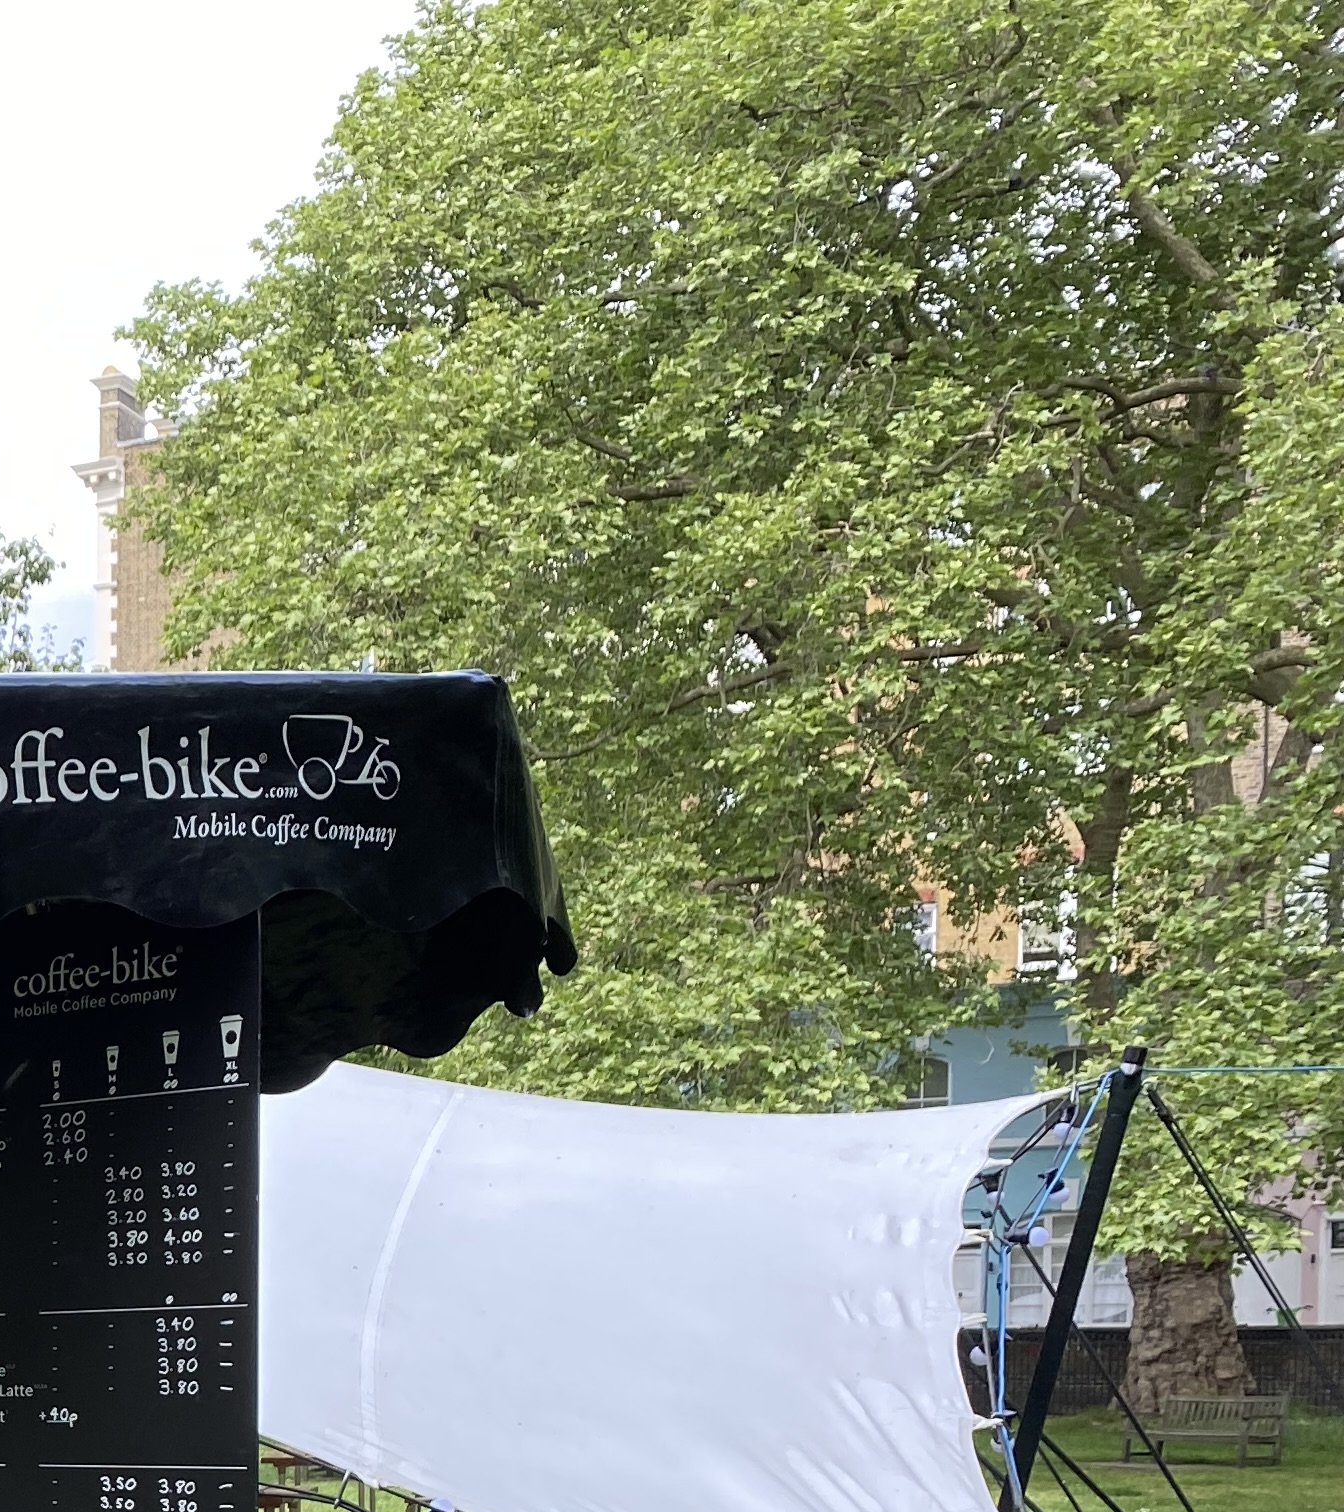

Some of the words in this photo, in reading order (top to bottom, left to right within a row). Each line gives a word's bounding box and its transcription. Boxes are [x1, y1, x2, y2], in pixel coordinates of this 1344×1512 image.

[172, 812, 246, 839] Mobile
[251, 814, 310, 846] Coffee
[314, 816, 397, 851] Company
[14, 941, 178, 997] coffee-bike
[14, 1001, 58, 1018] Mobile
[62, 995, 106, 1012] Coffee
[111, 988, 177, 1005] Company
[168, 1067, 174, 1077] L
[226, 1061, 238, 1071] XL
[42, 1110, 86, 1129] 2.00
[43, 1129, 85, 1145] 2.60
[43, 1147, 87, 1166] 2.40
[104, 1166, 142, 1183] 3.40
[161, 1161, 195, 1177] 3.80
[105, 1188, 144, 1205] 2.80
[161, 1184, 198, 1199] 3.20
[107, 1209, 146, 1225] 3.20
[162, 1207, 199, 1222] 3.60
[107, 1230, 148, 1248] 3.80
[164, 1229, 203, 1246] 4.00
[107, 1252, 147, 1266] 3.50
[164, 1250, 203, 1265] 3.80
[156, 1316, 194, 1332] 3.40
[158, 1337, 197, 1352] 3.80
[158, 1357, 198, 1374] 3.80
[0, 1384, 34, 1397] Latte
[158, 1379, 199, 1395] 3.80
[100, 1476, 137, 1491] 3.50
[158, 1478, 196, 1494] 3.80
[100, 1496, 134, 1510] 3.50
[160, 1498, 197, 1512] 3.80
